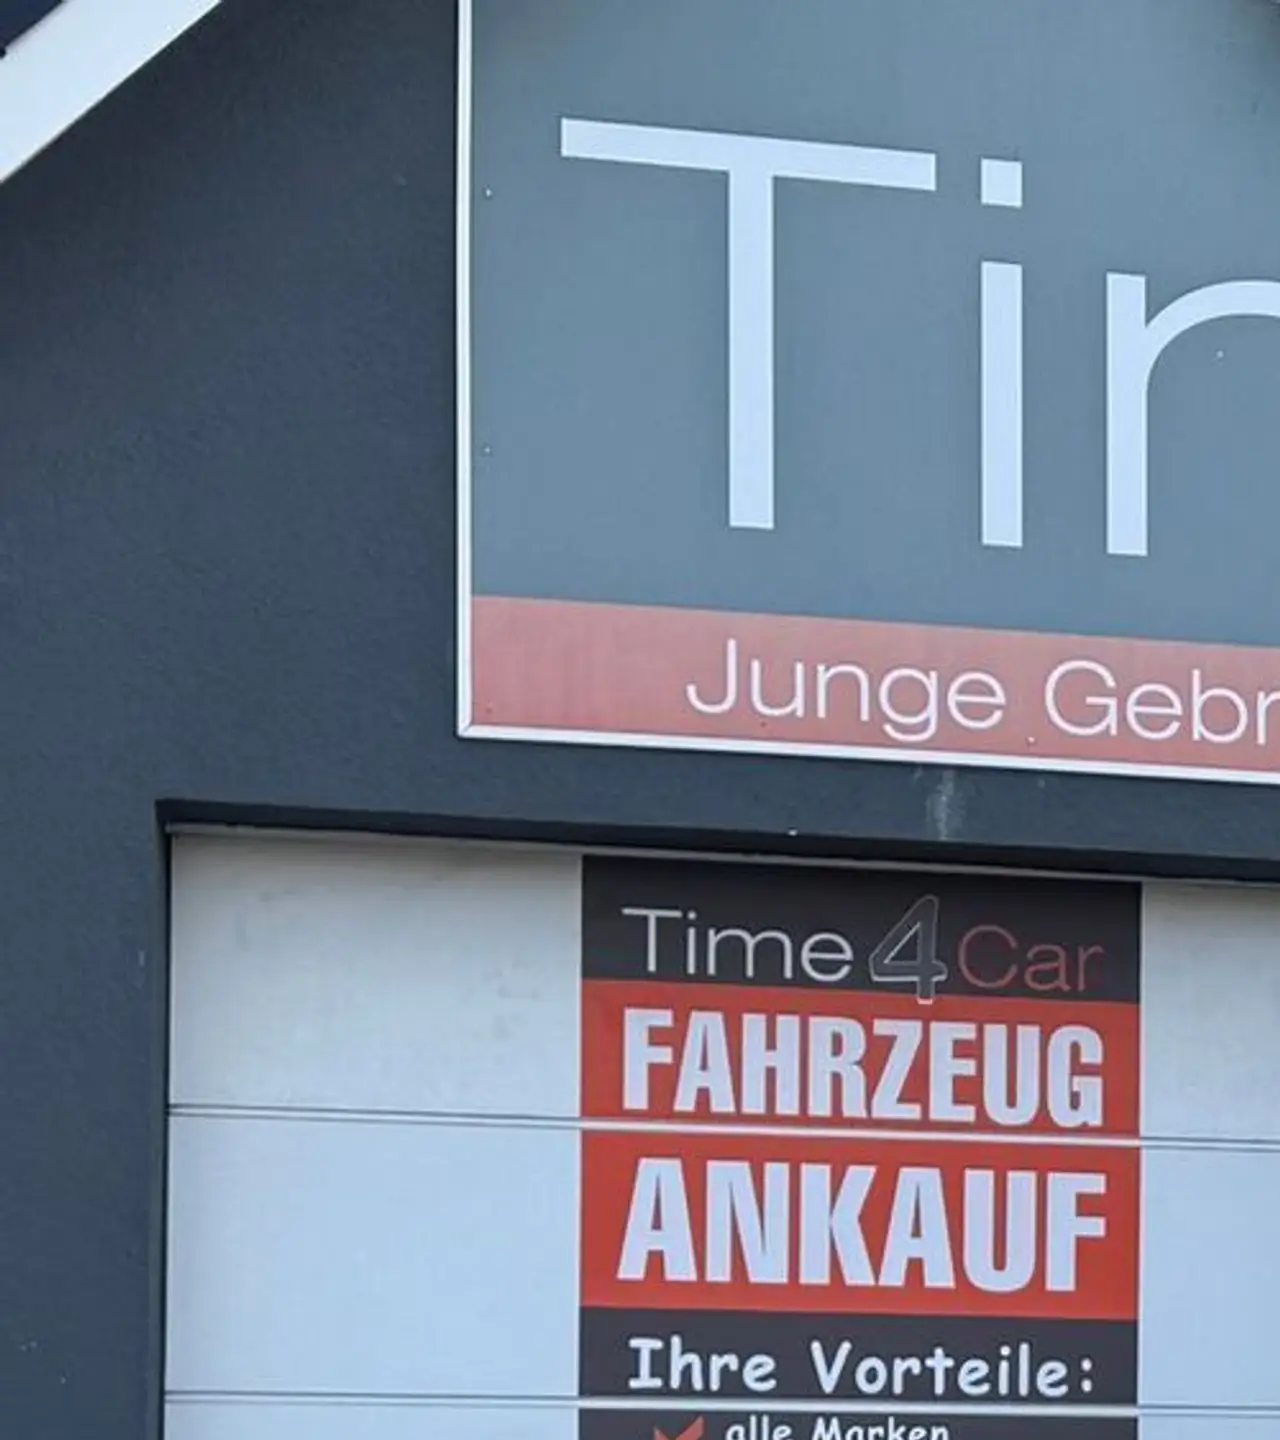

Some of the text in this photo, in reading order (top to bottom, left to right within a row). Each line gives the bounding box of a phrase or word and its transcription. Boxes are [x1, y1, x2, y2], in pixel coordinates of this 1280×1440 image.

[685, 638, 1007, 743] Junge
[622, 894, 1105, 1005] Time 4 Car
[622, 1007, 1105, 1129] FAHRZEUG
[616, 1157, 1107, 1293] ANKAUF
[628, 1334, 1094, 1399] Ihre Vorteile:
